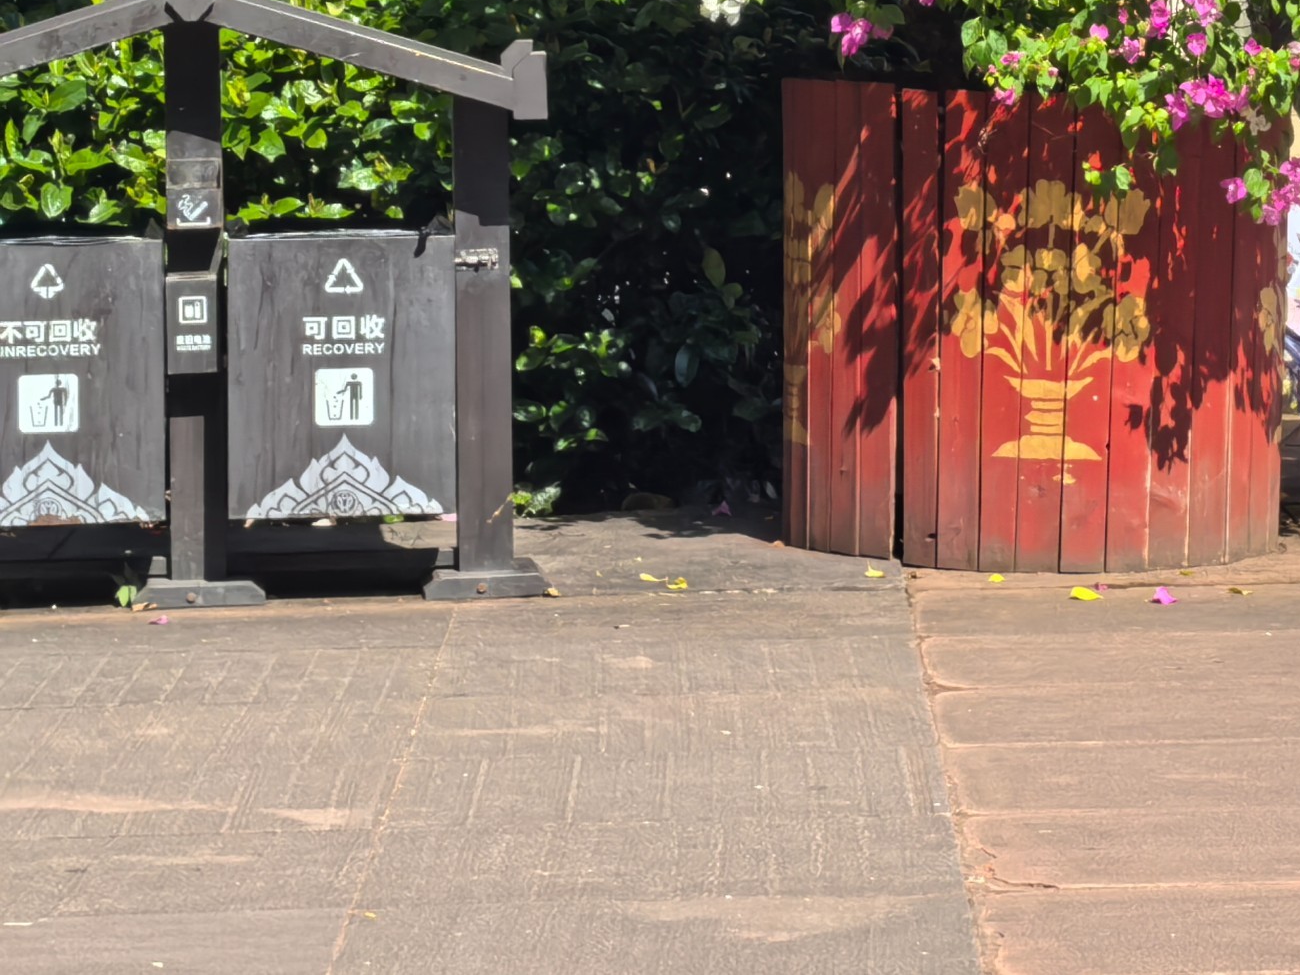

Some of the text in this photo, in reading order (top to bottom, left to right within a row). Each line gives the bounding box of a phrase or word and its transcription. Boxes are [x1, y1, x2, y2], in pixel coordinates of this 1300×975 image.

[0, 318, 97, 344] 不可回收
[302, 314, 385, 340] 可回收
[302, 342, 385, 355] RECOVERY
